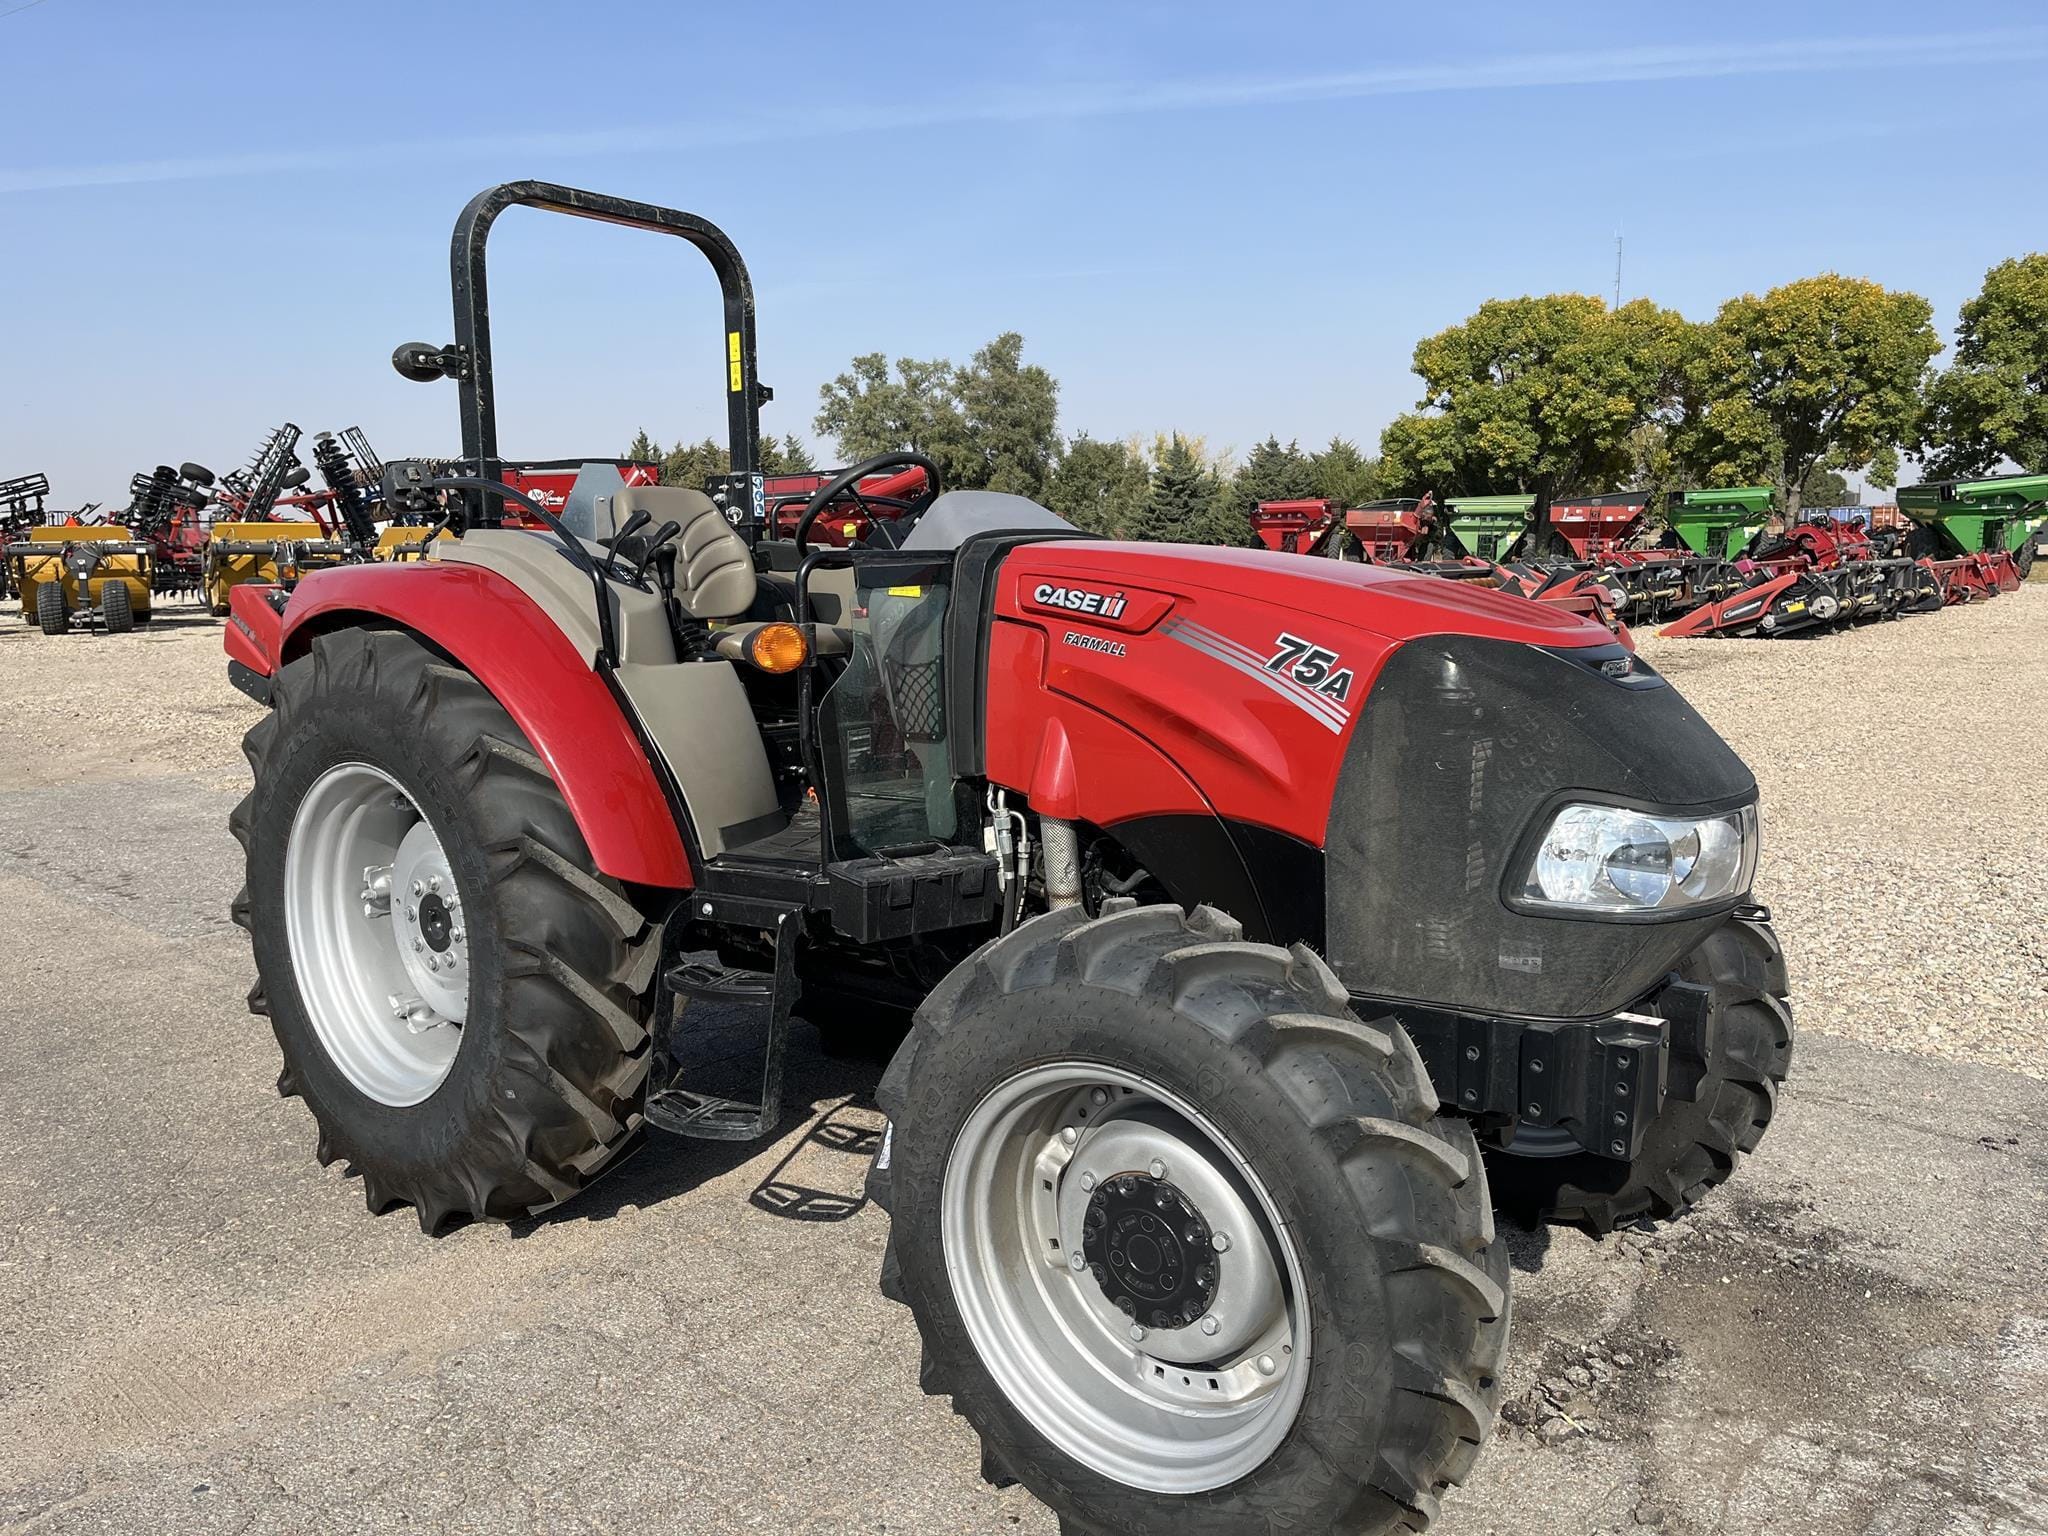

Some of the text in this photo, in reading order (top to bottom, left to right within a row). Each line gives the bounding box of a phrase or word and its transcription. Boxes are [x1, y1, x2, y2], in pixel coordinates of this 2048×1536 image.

[1033, 584, 1100, 614] CASE
[1062, 632, 1126, 657] FARMALL
[1263, 631, 1354, 702] 75A
